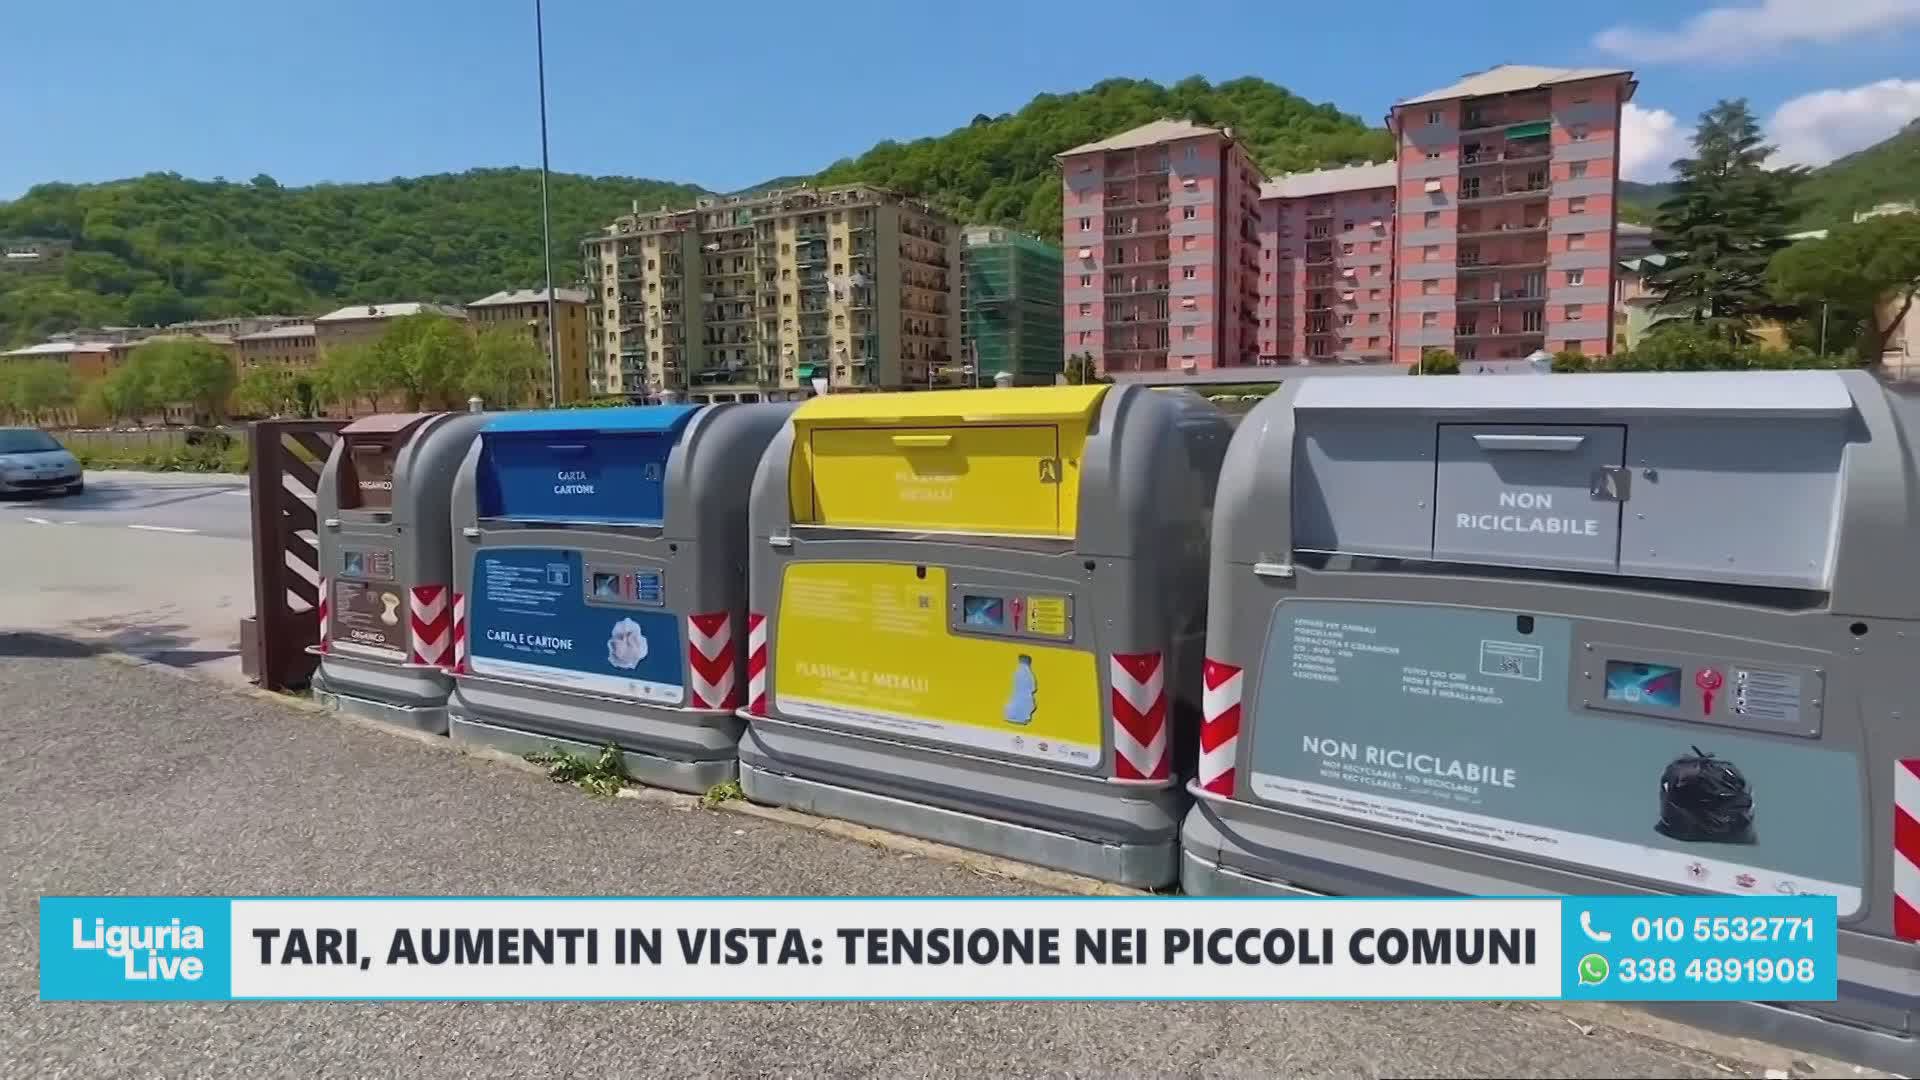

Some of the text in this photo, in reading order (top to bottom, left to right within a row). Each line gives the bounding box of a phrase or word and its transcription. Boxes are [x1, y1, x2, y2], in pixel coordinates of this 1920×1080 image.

[557, 471, 587, 480] CARTA
[553, 484, 595, 494] CARTONE
[1499, 492, 1553, 509] NON
[1456, 513, 1600, 536] RICICLABILE
[486, 629, 518, 644] CARTA
[519, 633, 525, 644] E
[526, 635, 574, 650] CARTONE
[1302, 735, 1517, 789] NON RICICLABILE
